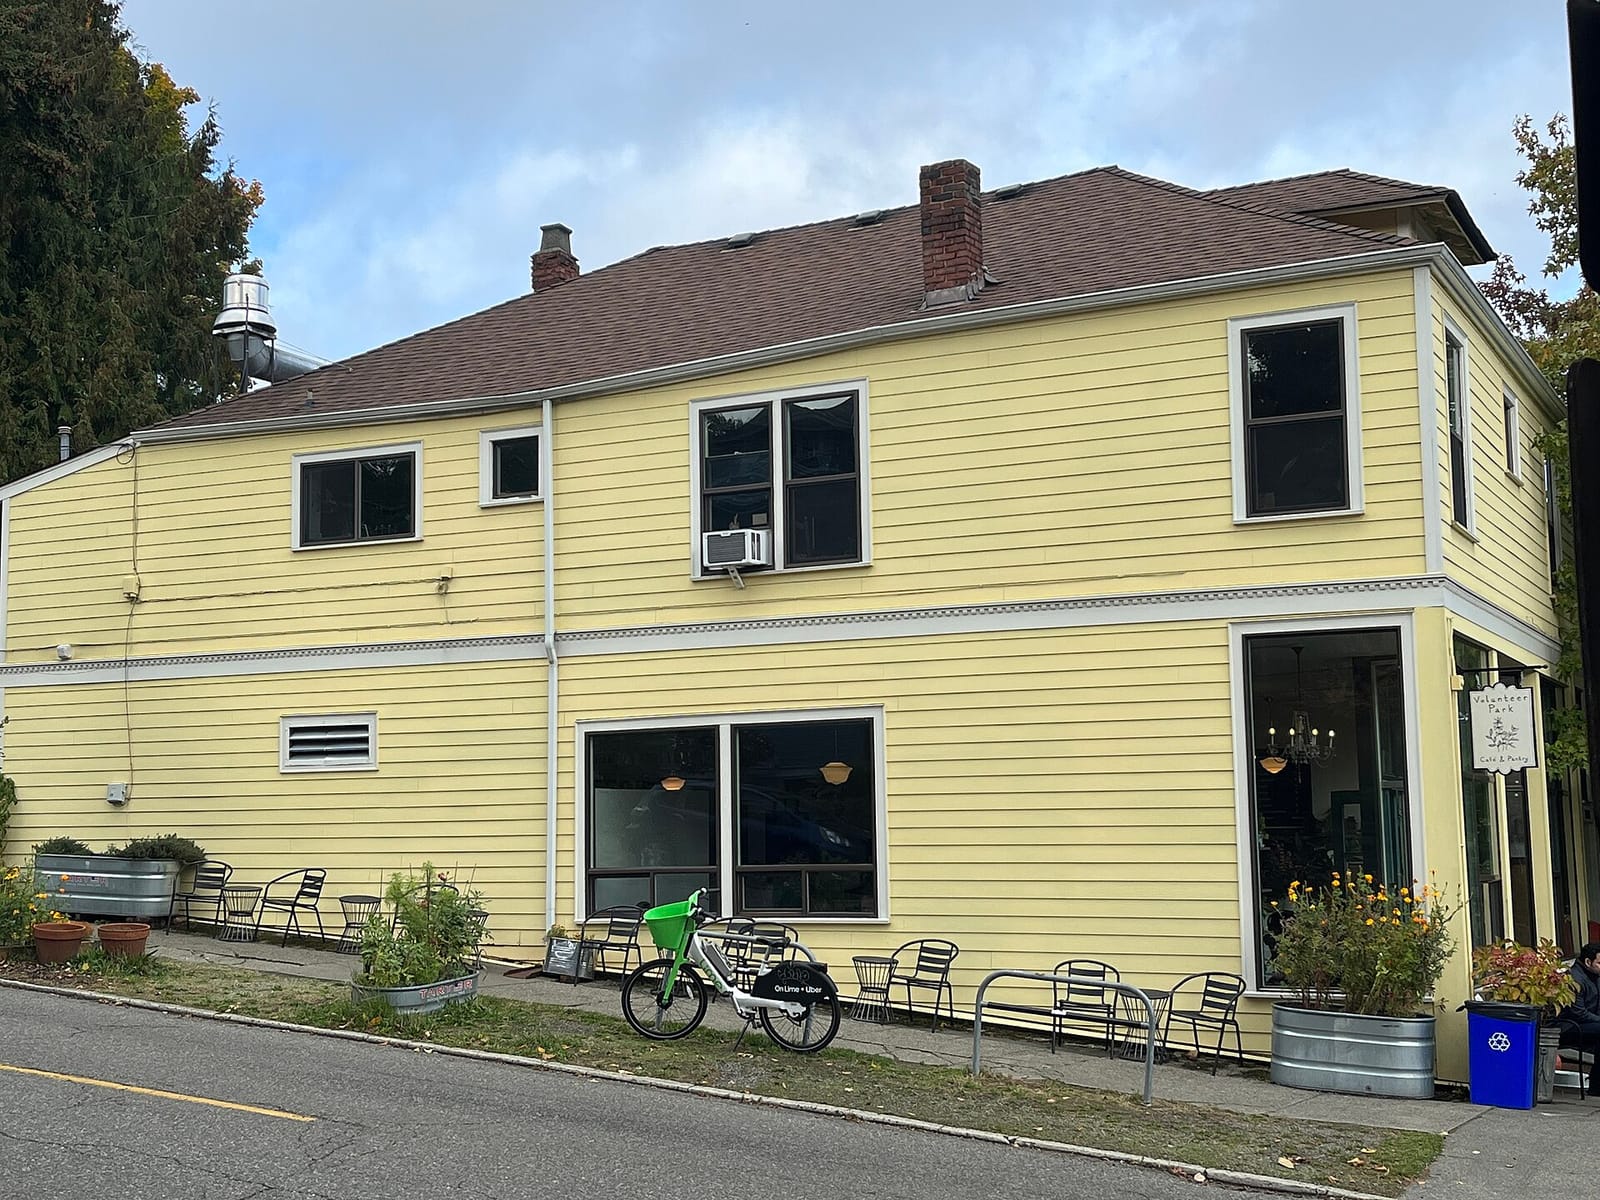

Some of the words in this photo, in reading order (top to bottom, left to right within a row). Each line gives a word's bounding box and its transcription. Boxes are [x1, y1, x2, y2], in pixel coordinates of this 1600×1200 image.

[1473, 694, 1528, 703] Volunteer
[1488, 703, 1514, 713] Park
[774, 984, 784, 993] On
[784, 985, 800, 993] Lime
[805, 985, 823, 993] Uber
